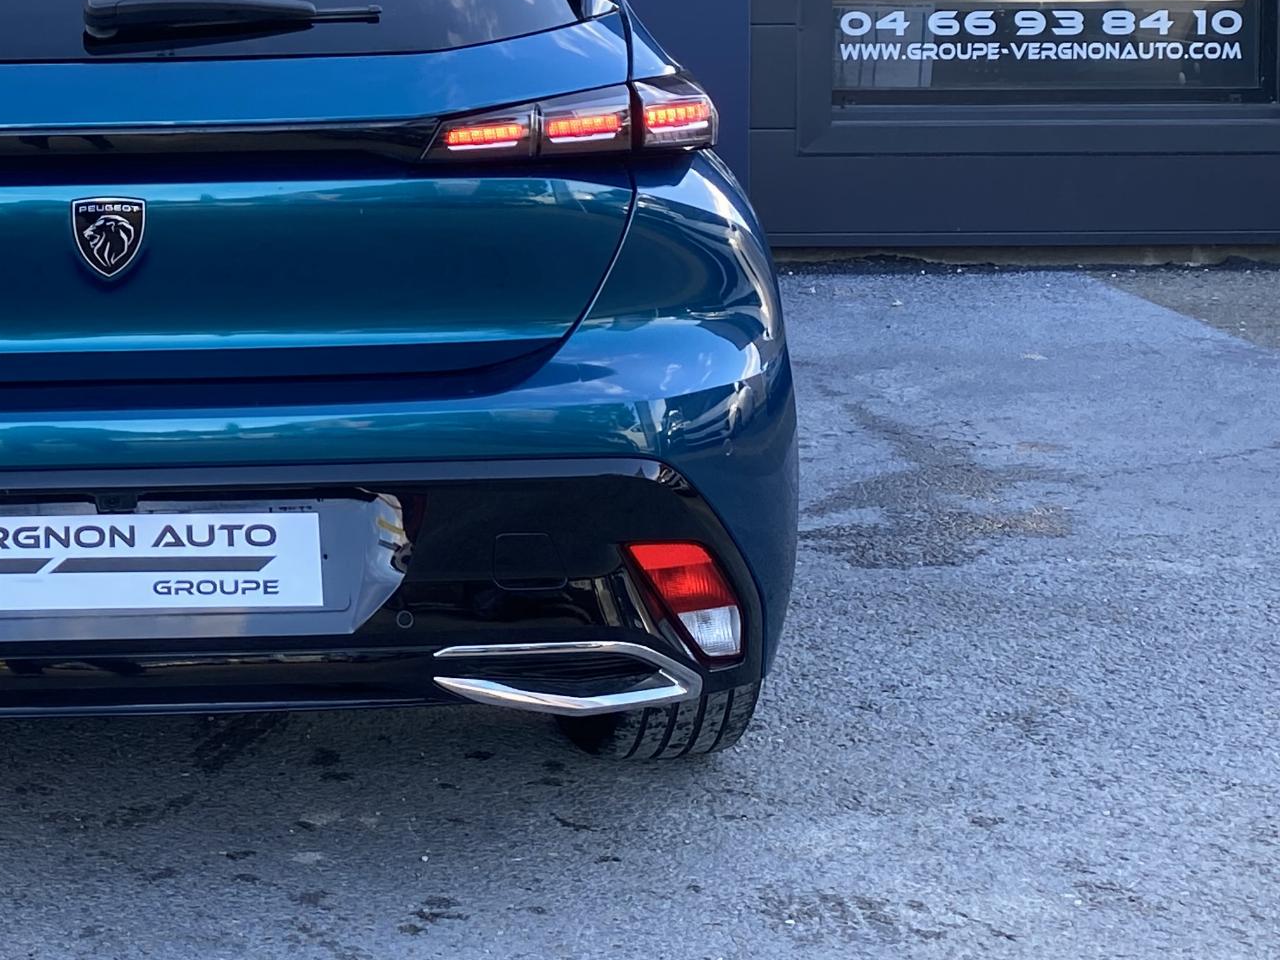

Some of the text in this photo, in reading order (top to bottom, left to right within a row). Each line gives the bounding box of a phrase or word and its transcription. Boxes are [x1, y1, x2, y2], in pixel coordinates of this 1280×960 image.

[840, 10, 1242, 36] 04 66 93 84 10
[840, 42, 1242, 60] WWW.GROUPE-VERGNONAUTO.COM
[79, 204, 140, 213] PEUGEOT
[152, 524, 276, 548] AUTO
[153, 579, 280, 595] GROUPE
